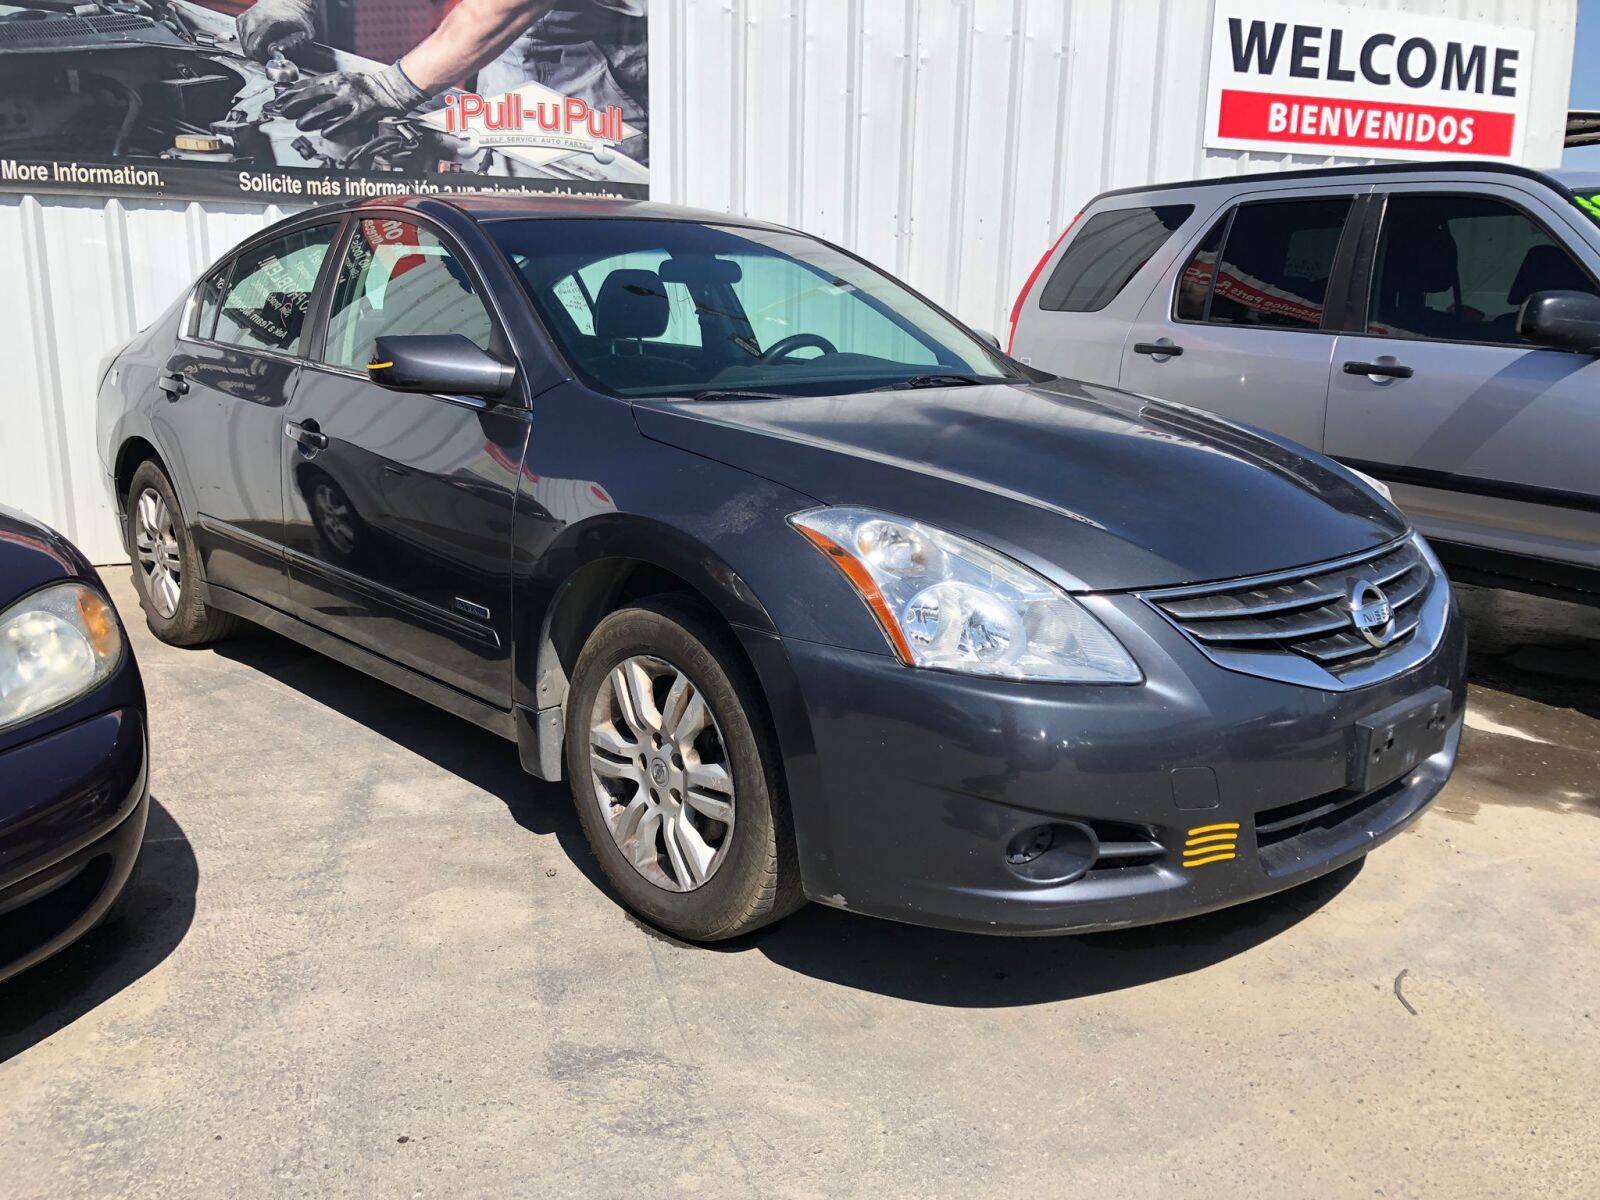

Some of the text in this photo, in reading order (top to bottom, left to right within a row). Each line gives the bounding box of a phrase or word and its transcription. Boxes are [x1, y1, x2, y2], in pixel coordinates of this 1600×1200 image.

[1228, 17, 1520, 97] WELCOME
[1267, 102, 1476, 146] BIENVENIDOS
[564, 140, 588, 149] PARTS
[0, 159, 165, 186] More Information.
[239, 171, 302, 194] Solicite
[307, 176, 341, 195] más
